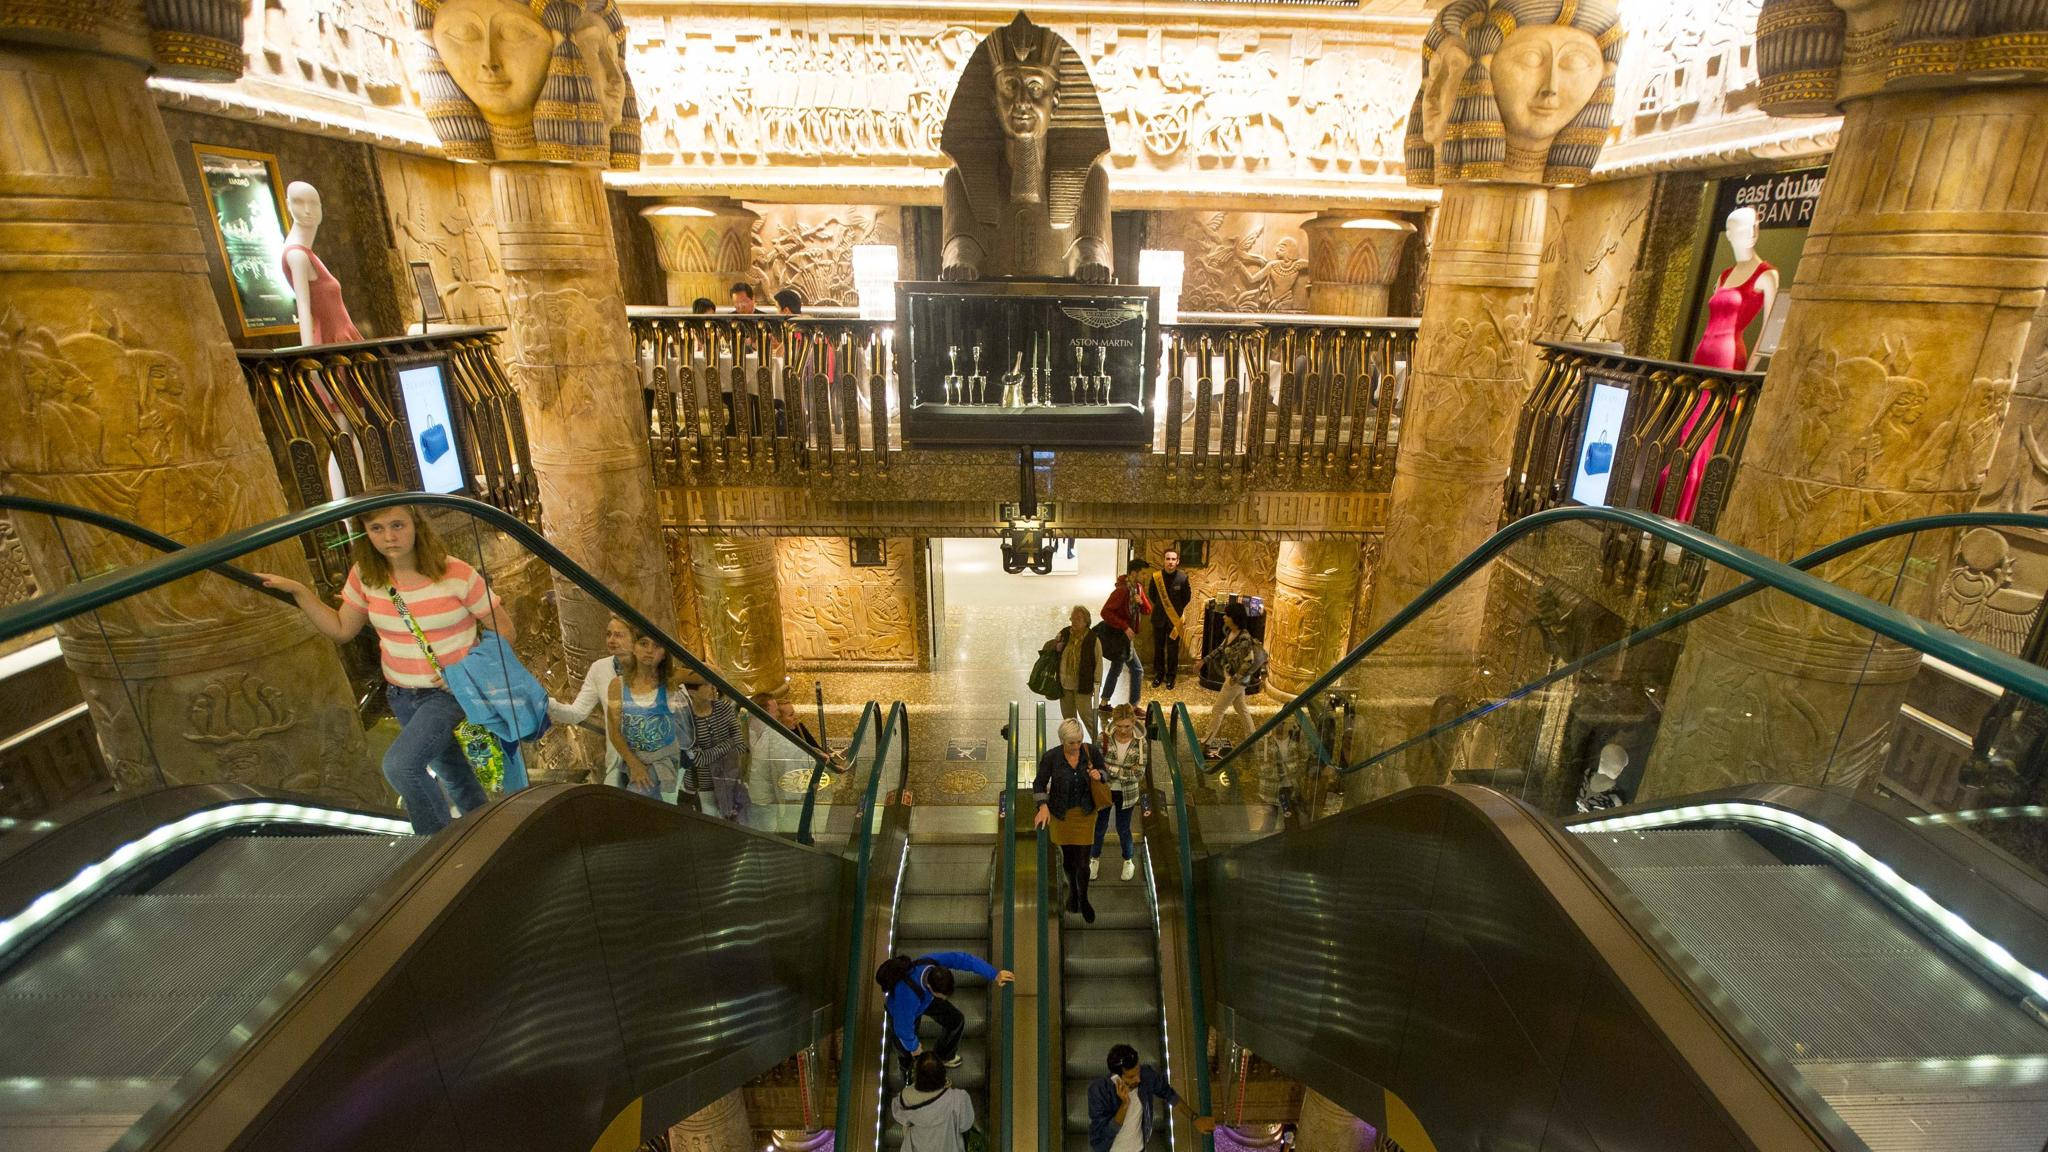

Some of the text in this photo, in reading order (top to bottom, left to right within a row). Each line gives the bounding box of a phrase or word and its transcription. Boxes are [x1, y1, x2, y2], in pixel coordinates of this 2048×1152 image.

[1736, 179, 1773, 205] east
[1750, 200, 1795, 222] BAN
[1069, 338, 1134, 348] ASTON MARTIN
[1005, 505, 1050, 519] FLR
